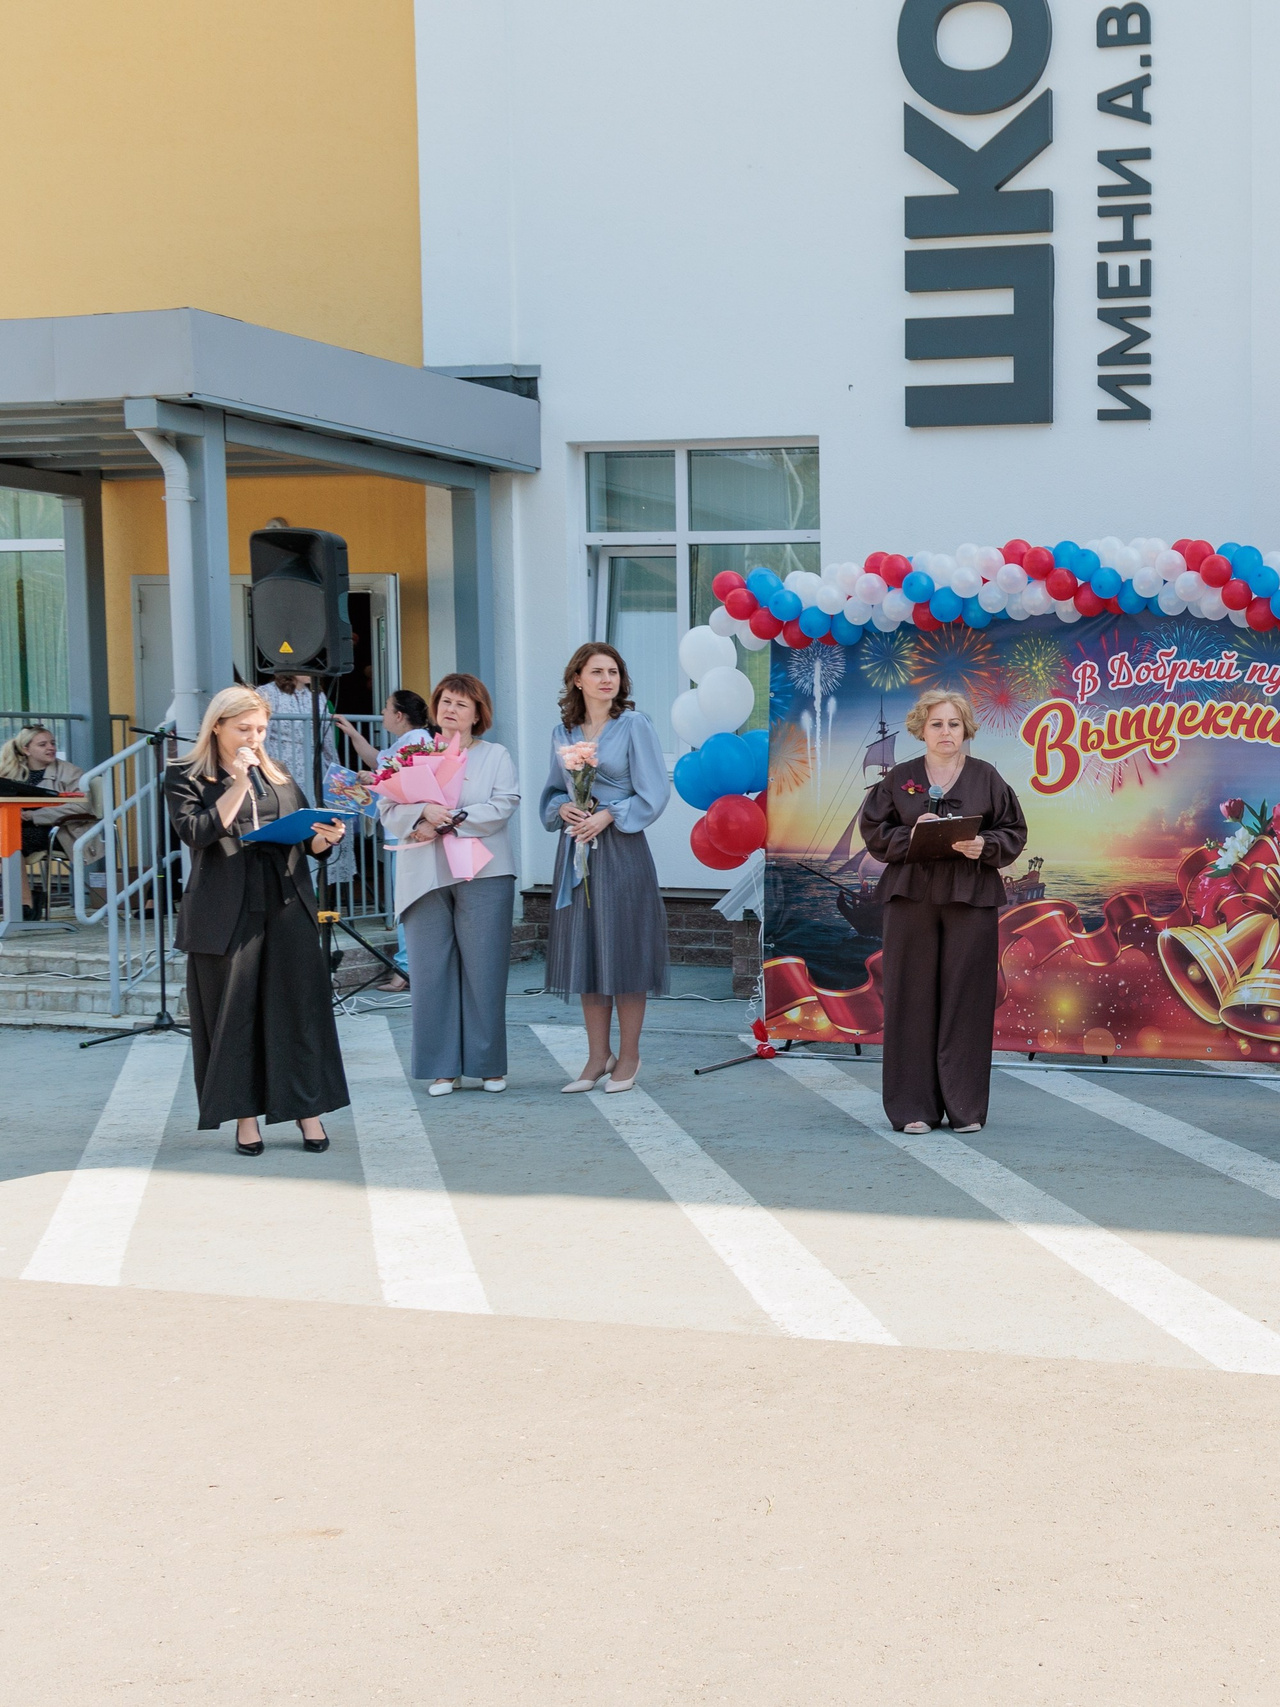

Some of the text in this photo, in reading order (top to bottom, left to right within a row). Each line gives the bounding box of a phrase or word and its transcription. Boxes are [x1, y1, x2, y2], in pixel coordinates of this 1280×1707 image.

[898, 0, 1054, 427] ШКО
[1096, 2, 1152, 421] ИМЕНИ А.В
[1074, 661, 1100, 703] В
[1111, 646, 1240, 693] Добрый
